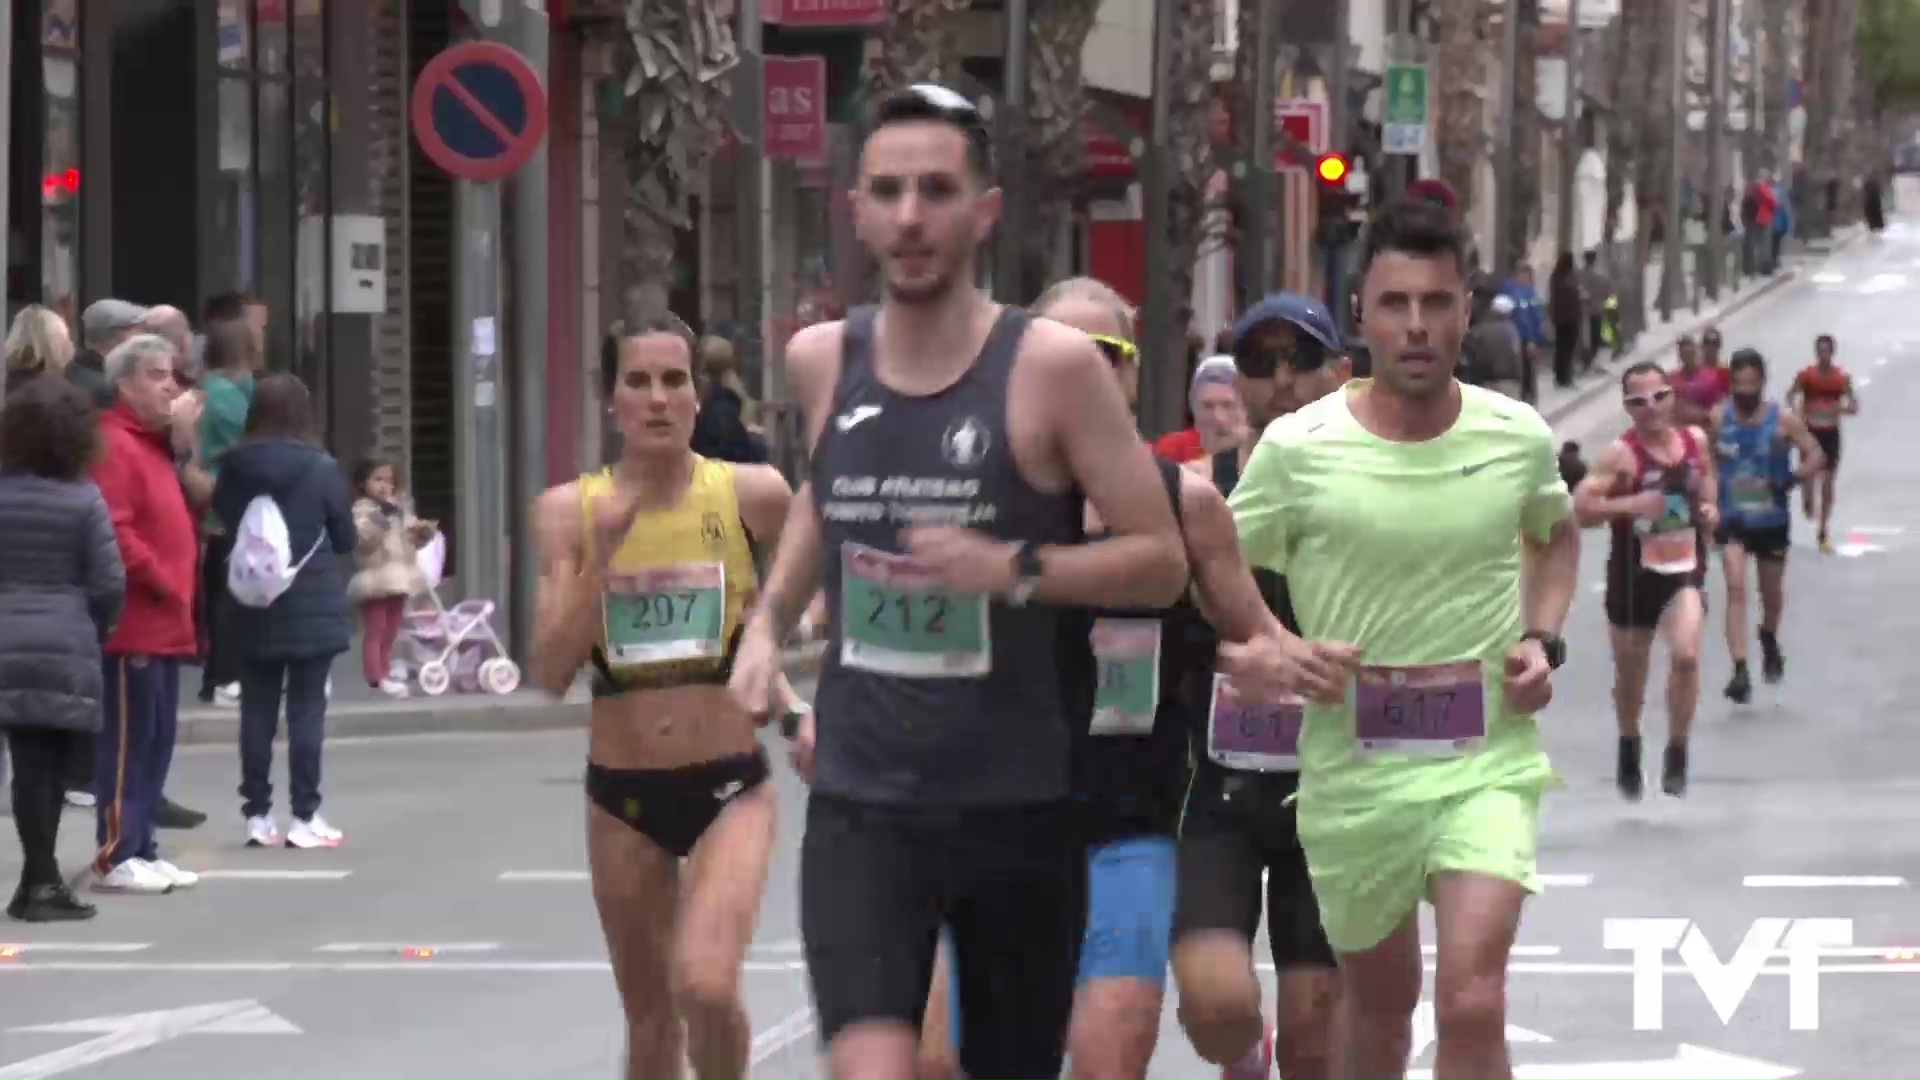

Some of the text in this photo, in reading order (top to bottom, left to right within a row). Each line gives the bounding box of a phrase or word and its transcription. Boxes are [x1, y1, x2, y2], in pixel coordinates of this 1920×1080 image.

[631, 591, 698, 630] 207
[868, 586, 946, 635] 212
[1383, 688, 1457, 733] 617
